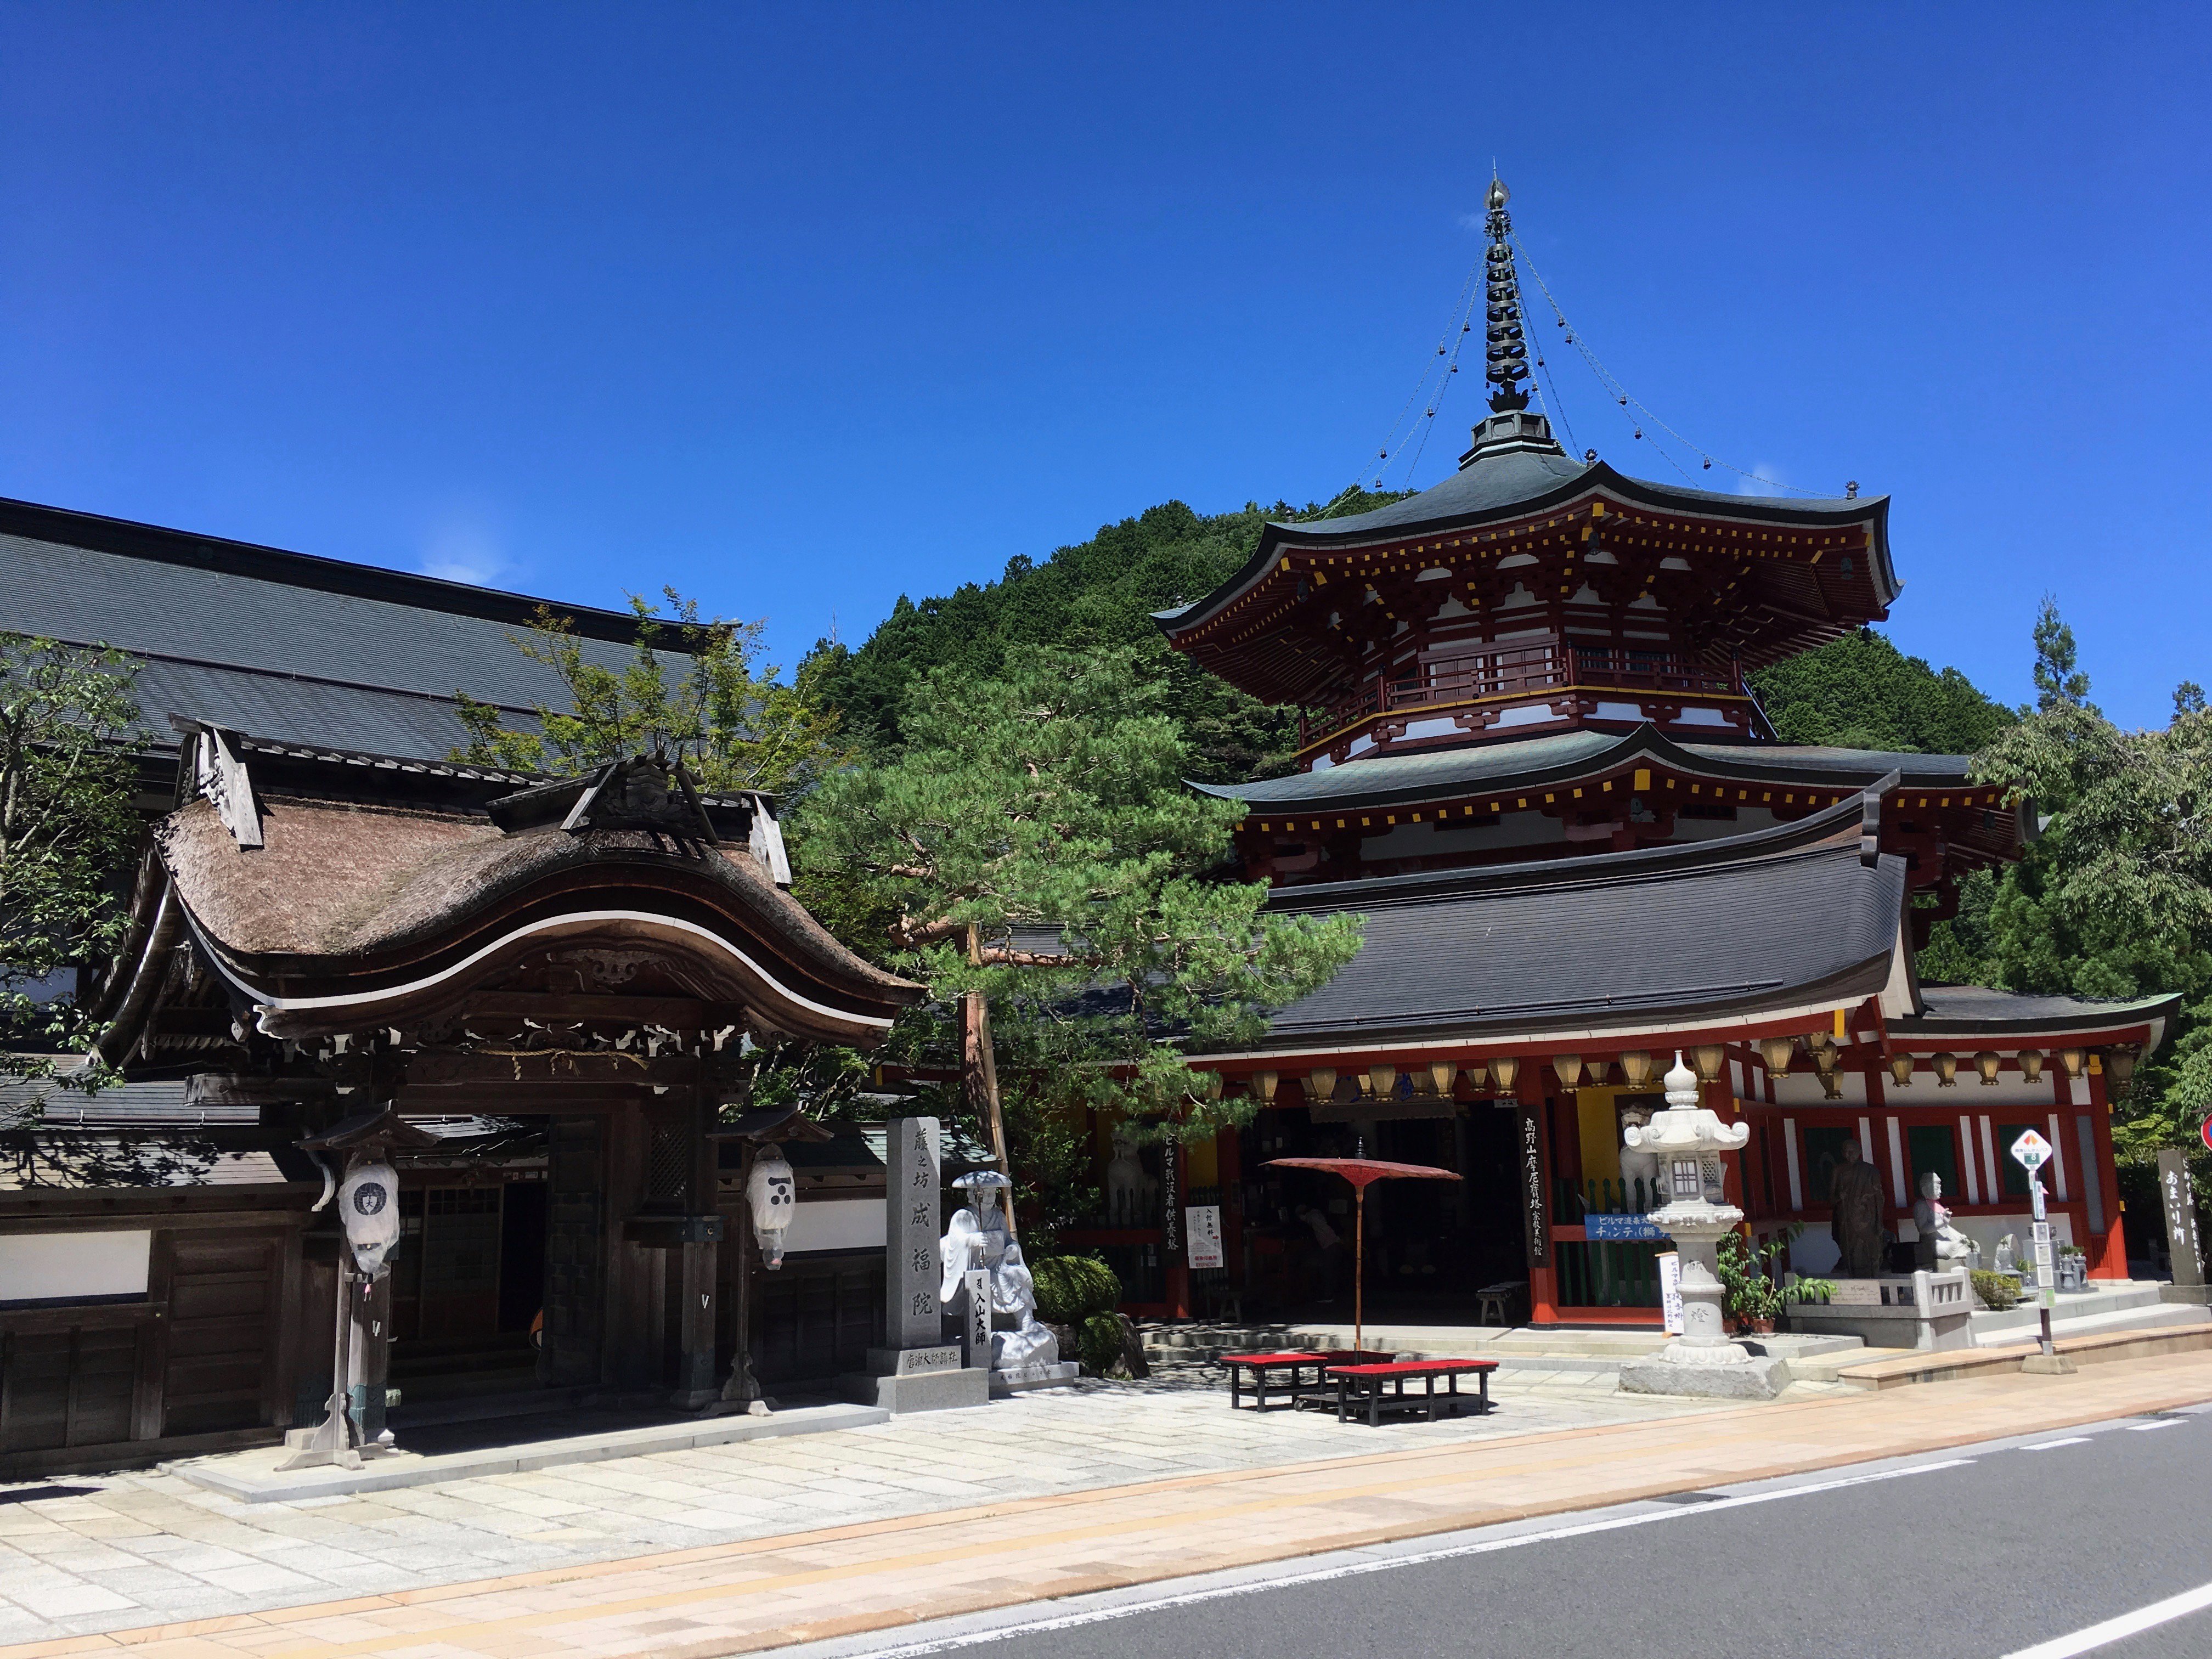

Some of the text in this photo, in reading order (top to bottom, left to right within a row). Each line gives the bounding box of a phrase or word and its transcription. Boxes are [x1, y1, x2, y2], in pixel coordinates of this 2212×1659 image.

[2166, 1170, 2185, 1245] おまいり所
[975, 1293, 986, 1346] 入山大師
